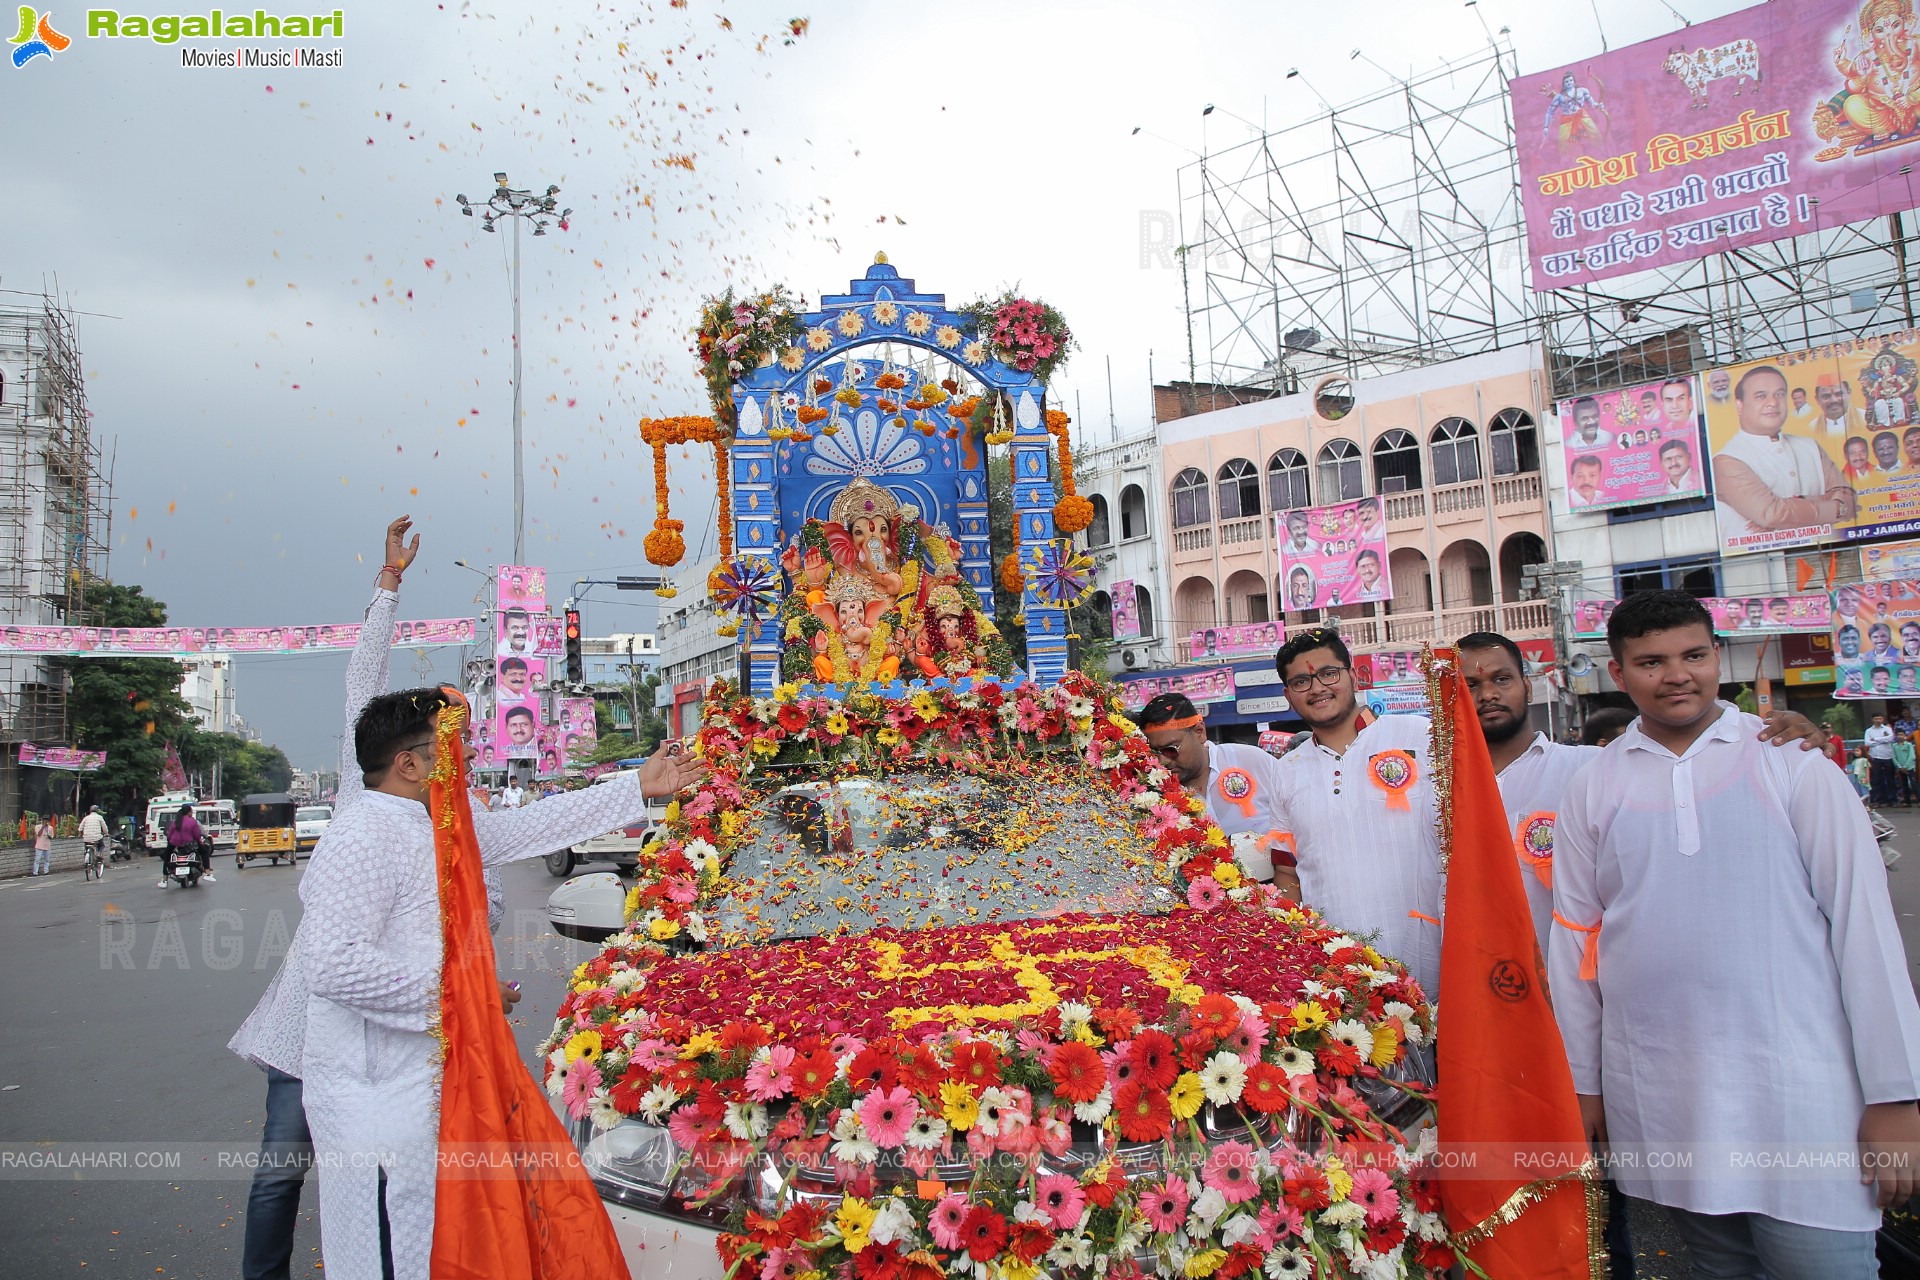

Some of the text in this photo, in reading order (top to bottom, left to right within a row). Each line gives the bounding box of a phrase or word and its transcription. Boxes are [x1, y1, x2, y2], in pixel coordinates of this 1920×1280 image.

[1537, 110, 1791, 197] गणेश विसर्जन
[1551, 151, 1790, 240] में पधारे सभी भक्तों
[1543, 252, 1581, 278] का
[1585, 229, 1661, 270] हार्दिक
[1668, 206, 1763, 249] स्वागत
[1727, 536, 1739, 547] SRI
[1774, 528, 1797, 542] BISWA
[1797, 525, 1823, 539] SARMA
[1823, 523, 1832, 535] JI
[1847, 521, 1920, 539] BJP JAMBAG
[1386, 701, 1421, 710] DRINKING
